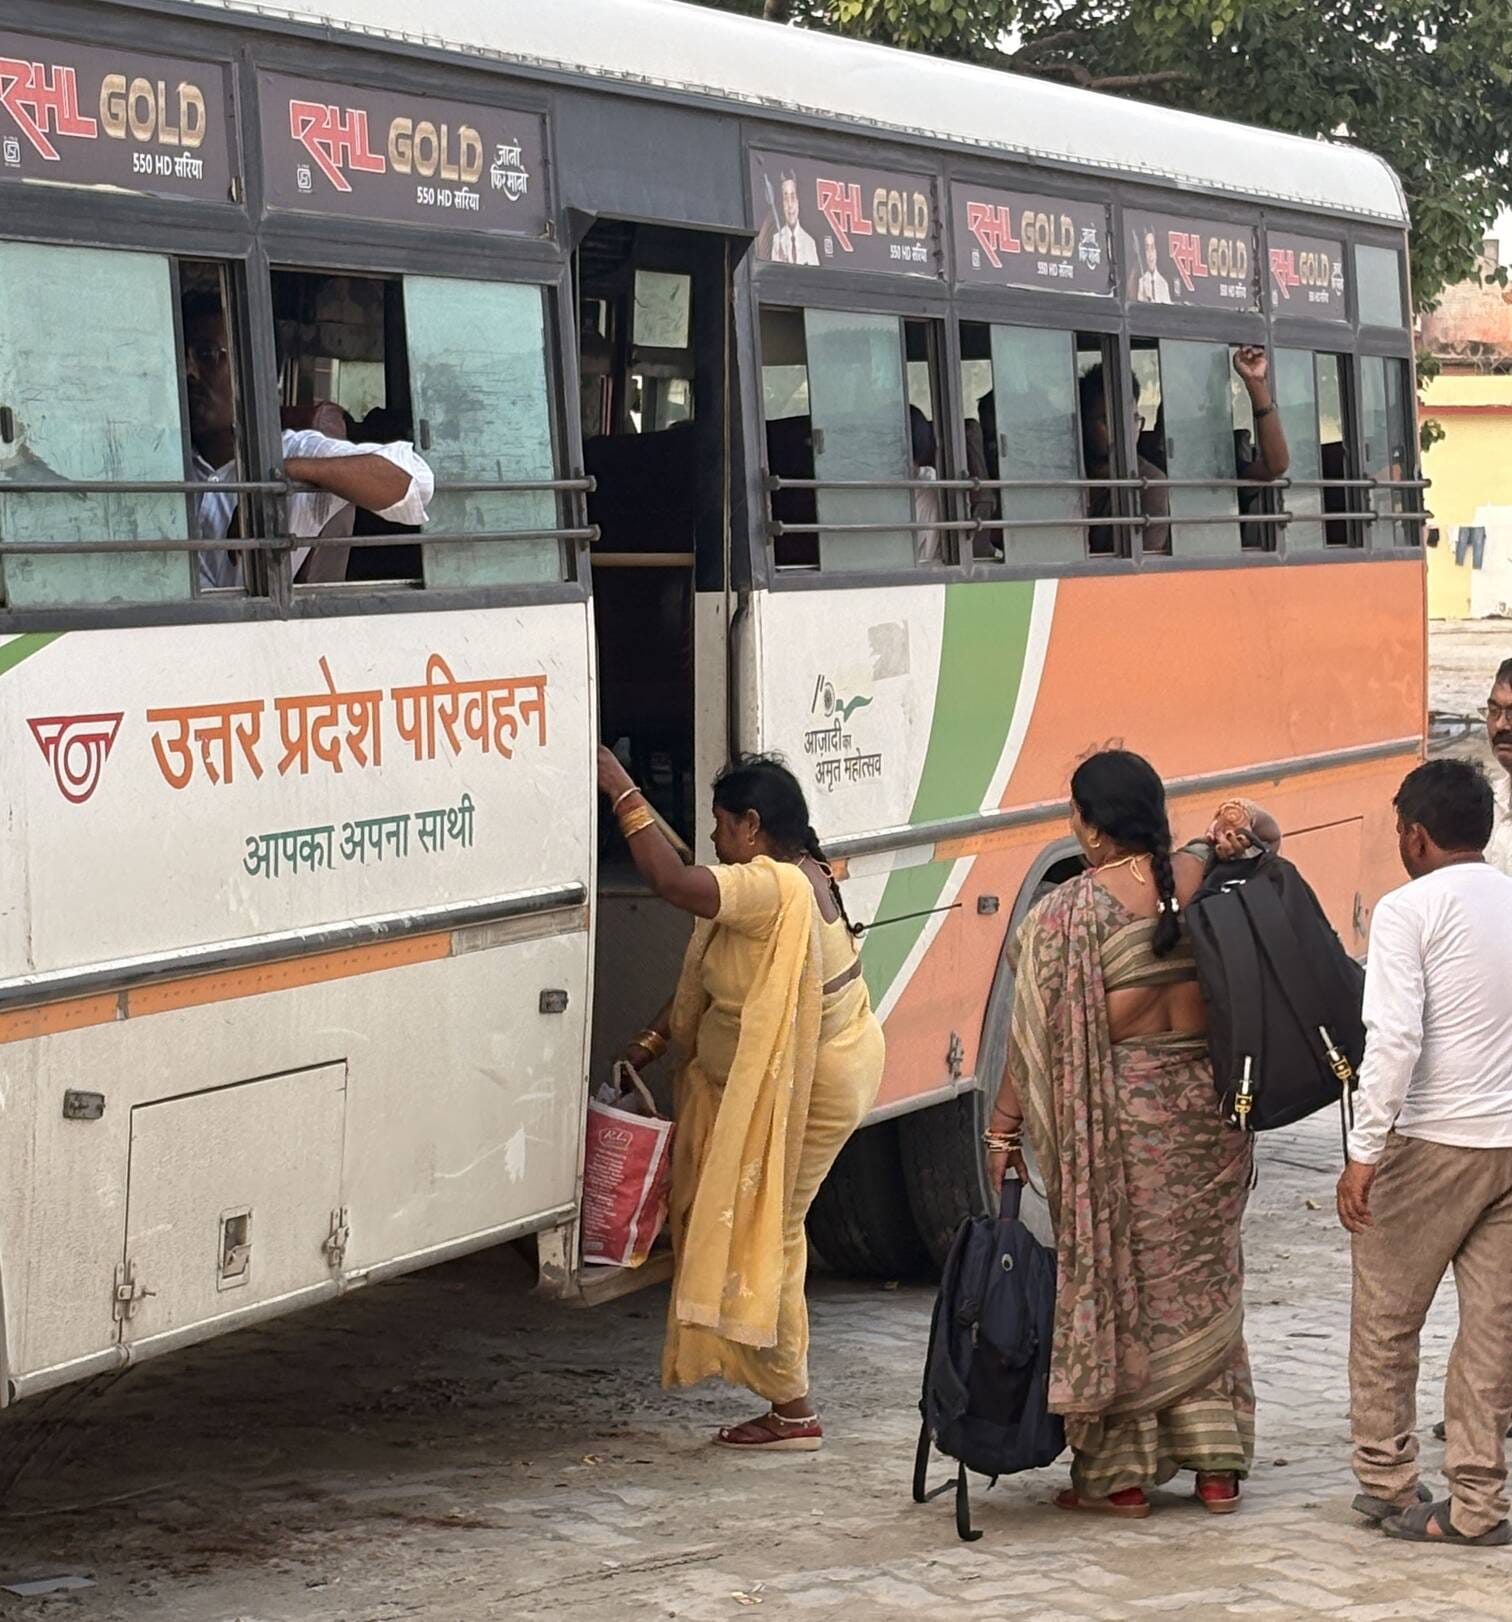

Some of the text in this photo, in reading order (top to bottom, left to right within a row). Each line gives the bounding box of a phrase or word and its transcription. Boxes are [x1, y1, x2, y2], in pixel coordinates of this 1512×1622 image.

[100, 73, 206, 148] GOLD
[133, 152, 203, 180] 550 HD सरिया
[387, 116, 483, 184] GOLD
[417, 186, 480, 211] 550 HD सरिया
[873, 188, 928, 239] GOLD
[1021, 210, 1075, 257] GOLD
[1208, 237, 1248, 279] GOLD
[1300, 251, 1329, 287] GOLD
[146, 653, 548, 789] उत्तर प्रदेश परिवहन
[815, 748, 883, 792] अमृत महोत्सव
[242, 793, 476, 879] आपका अपना साथी
